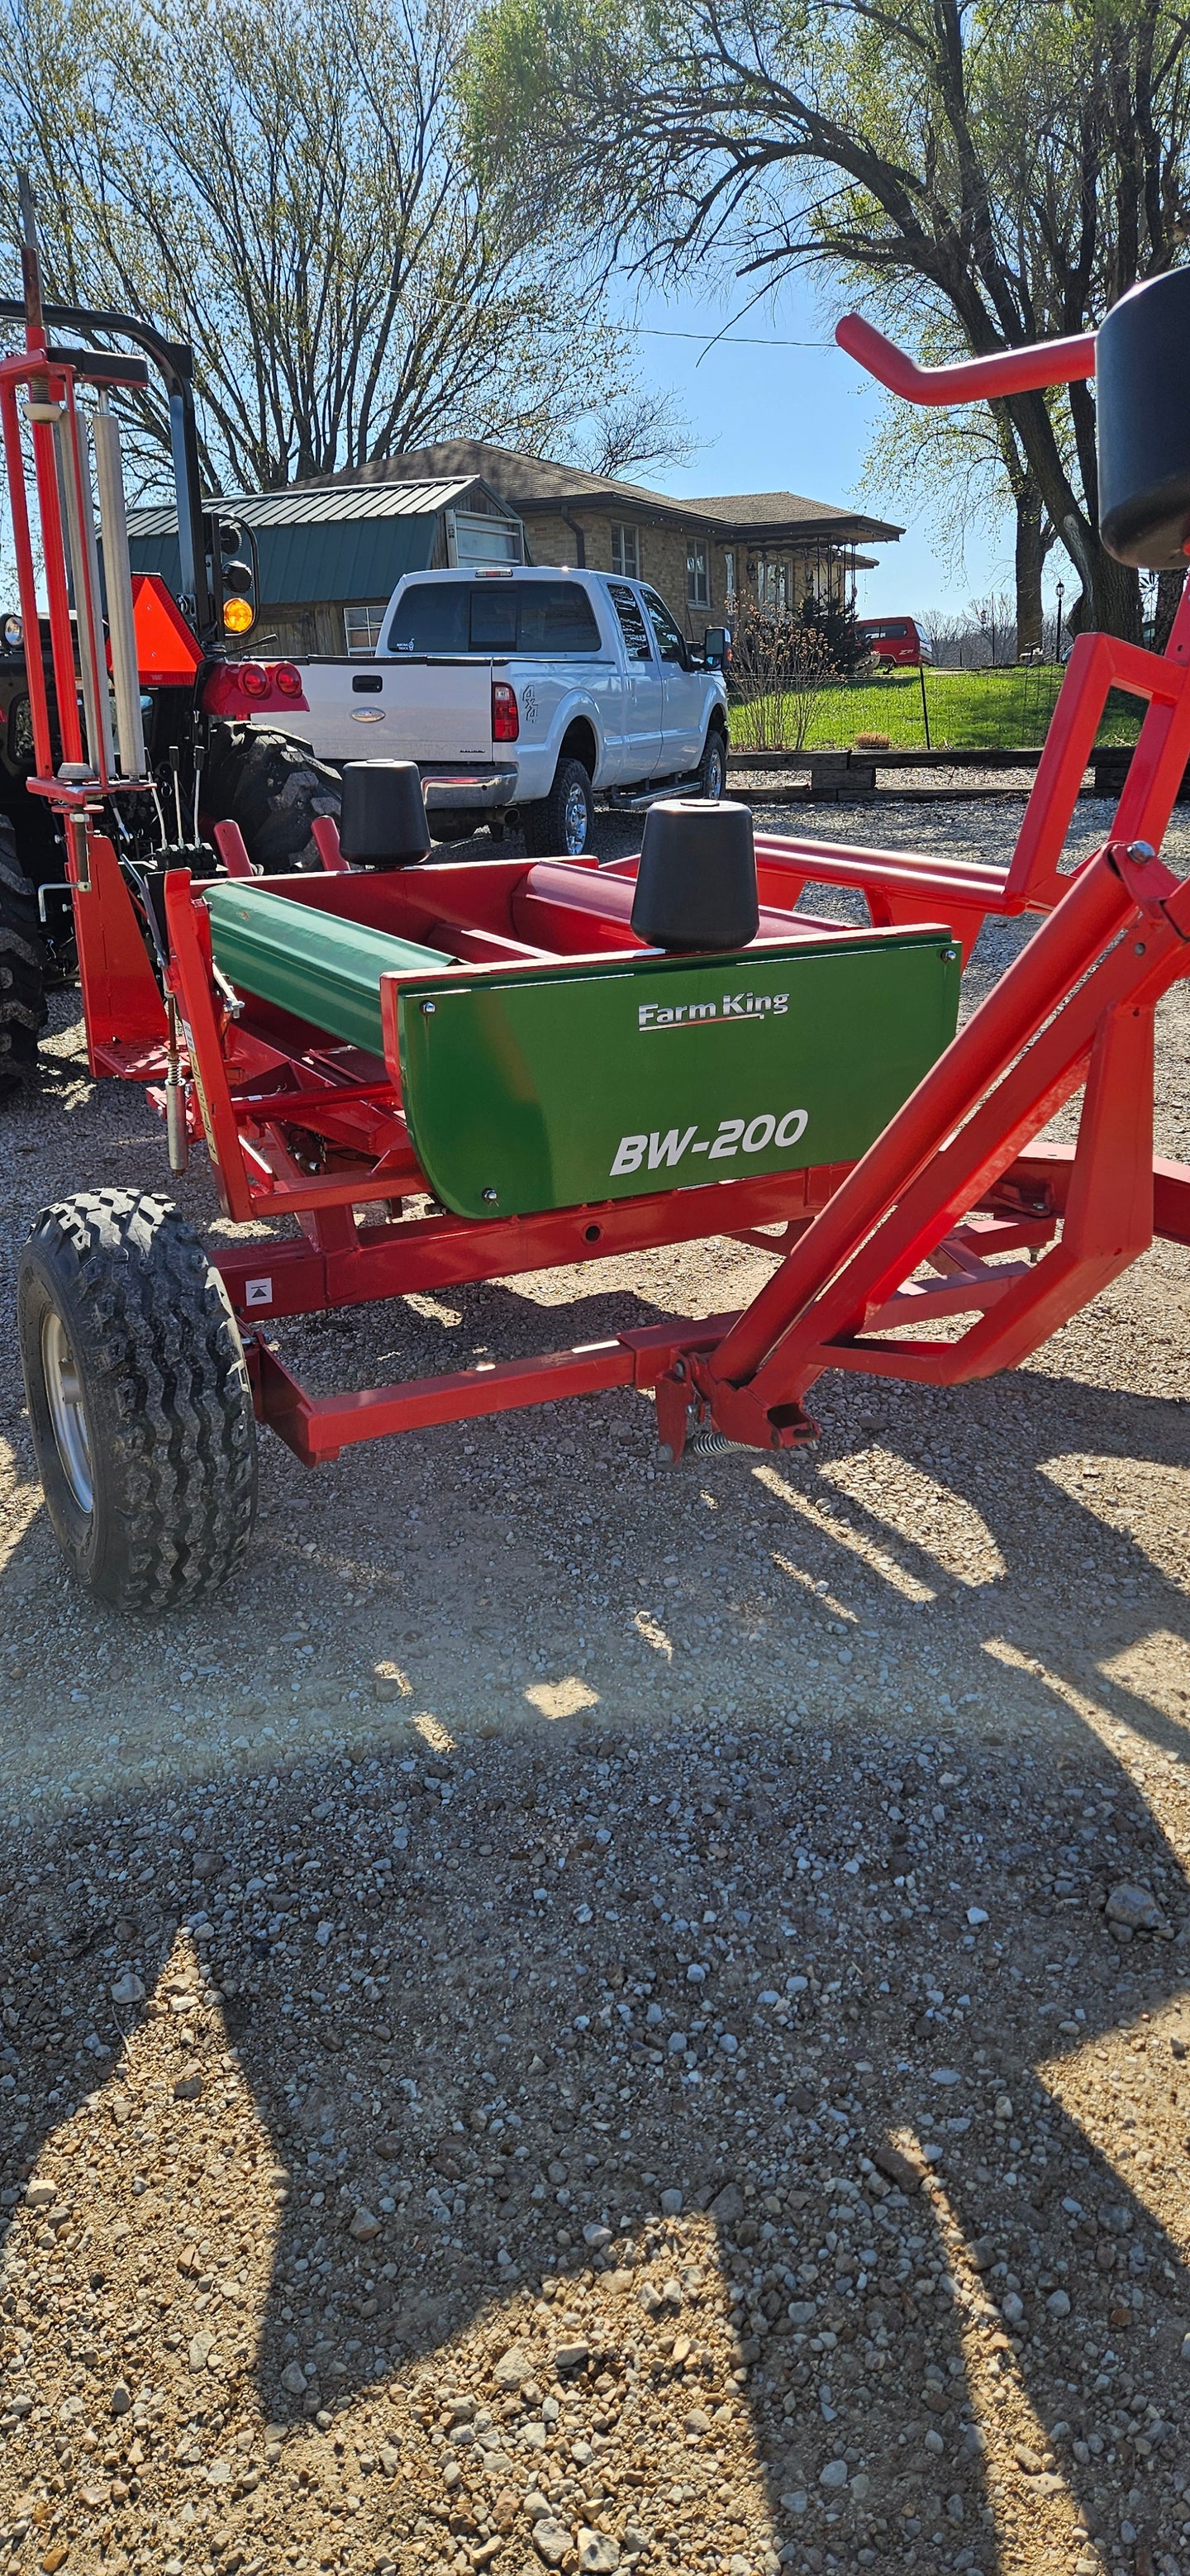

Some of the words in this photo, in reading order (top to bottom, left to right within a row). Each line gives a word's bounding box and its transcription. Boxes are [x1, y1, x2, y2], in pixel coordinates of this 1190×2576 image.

[638, 1002, 717, 1026] Farm
[721, 992, 790, 1015] King
[609, 1109, 809, 1177] BW-200
